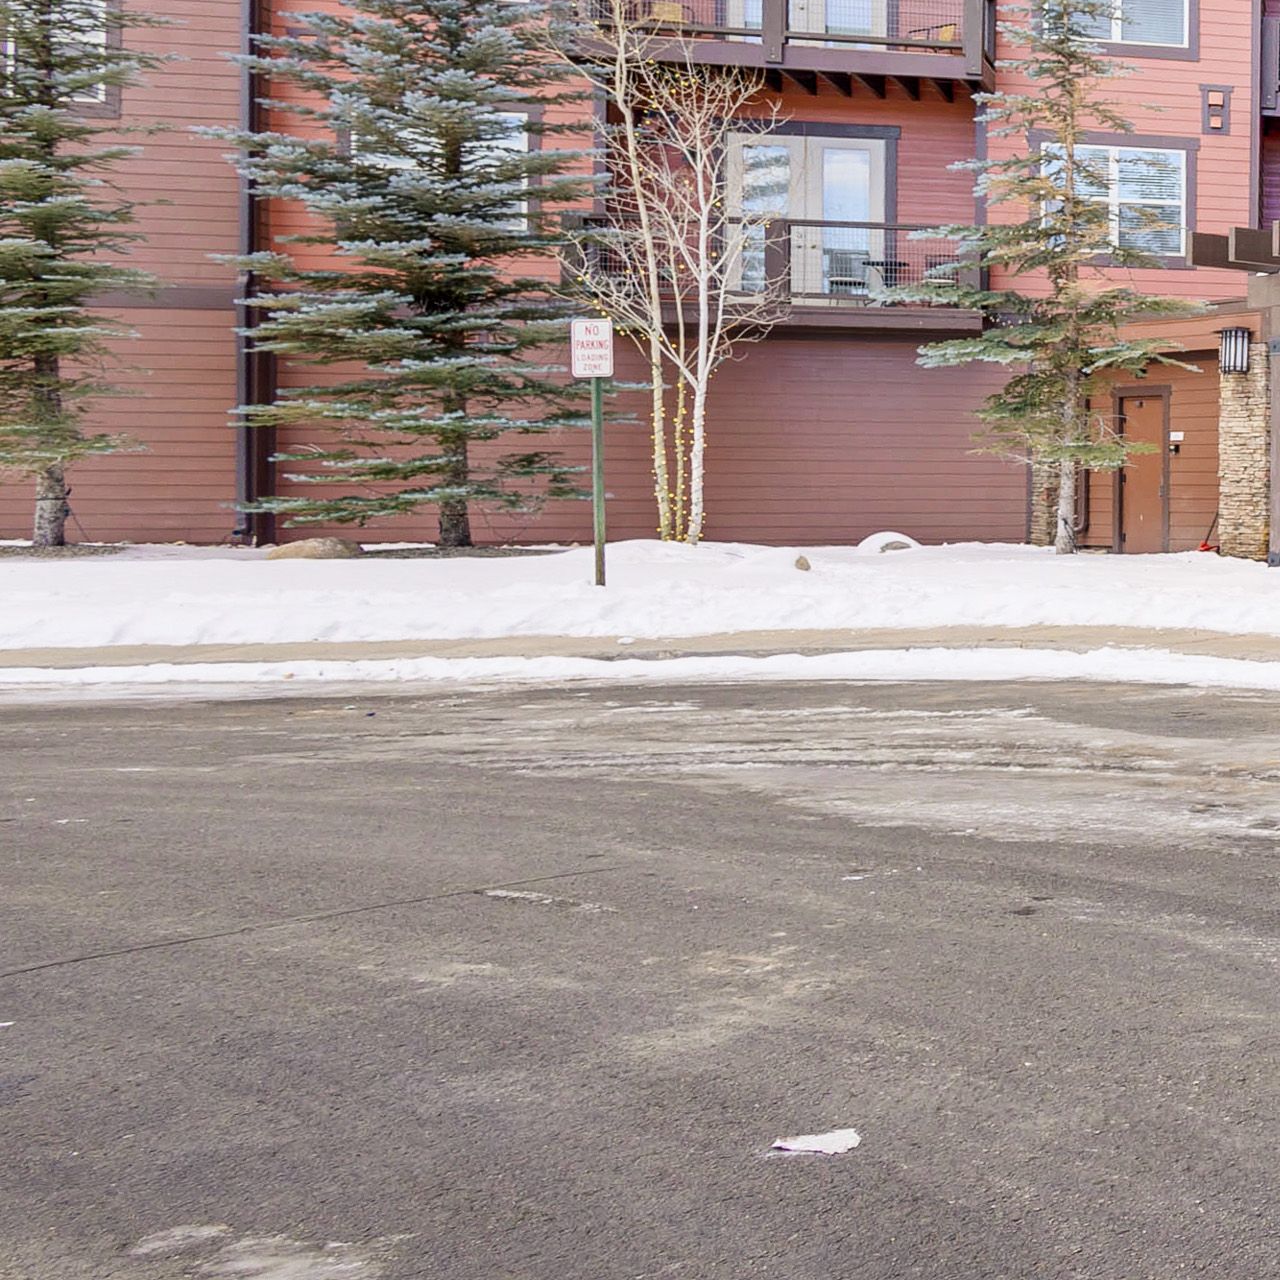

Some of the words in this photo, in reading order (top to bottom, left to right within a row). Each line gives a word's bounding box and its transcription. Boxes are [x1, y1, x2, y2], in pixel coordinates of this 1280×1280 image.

[584, 325, 600, 336] NO
[576, 340, 609, 350] PARKING
[576, 353, 609, 362] LOADING
[583, 363, 603, 371] ZONE
